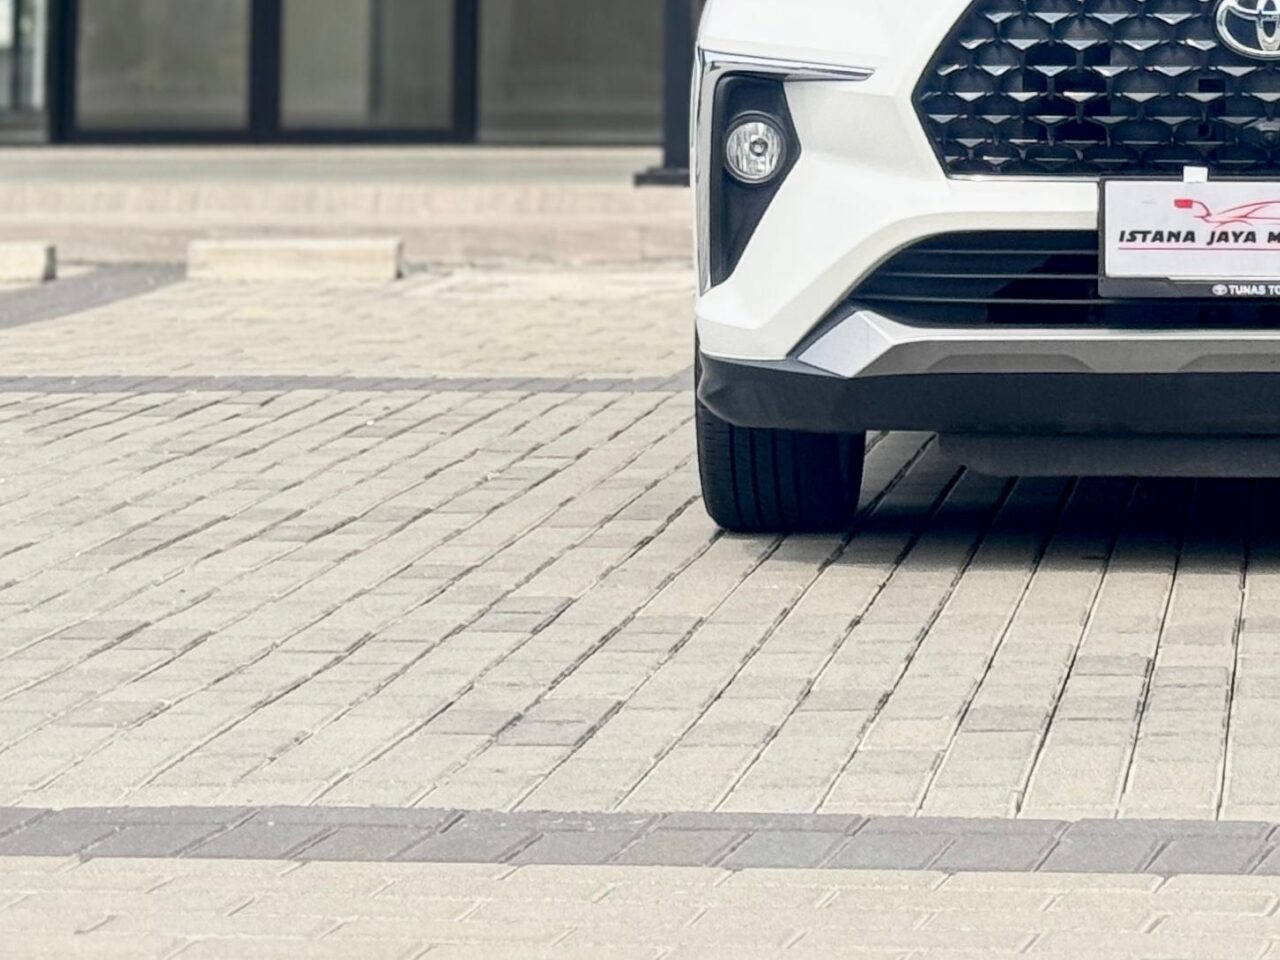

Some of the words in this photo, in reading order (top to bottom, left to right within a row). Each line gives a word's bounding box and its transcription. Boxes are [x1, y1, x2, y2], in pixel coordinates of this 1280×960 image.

[1119, 230, 1195, 243] ISTANA
[1206, 230, 1256, 246] JAYA
[1228, 284, 1266, 295] TUNAS
